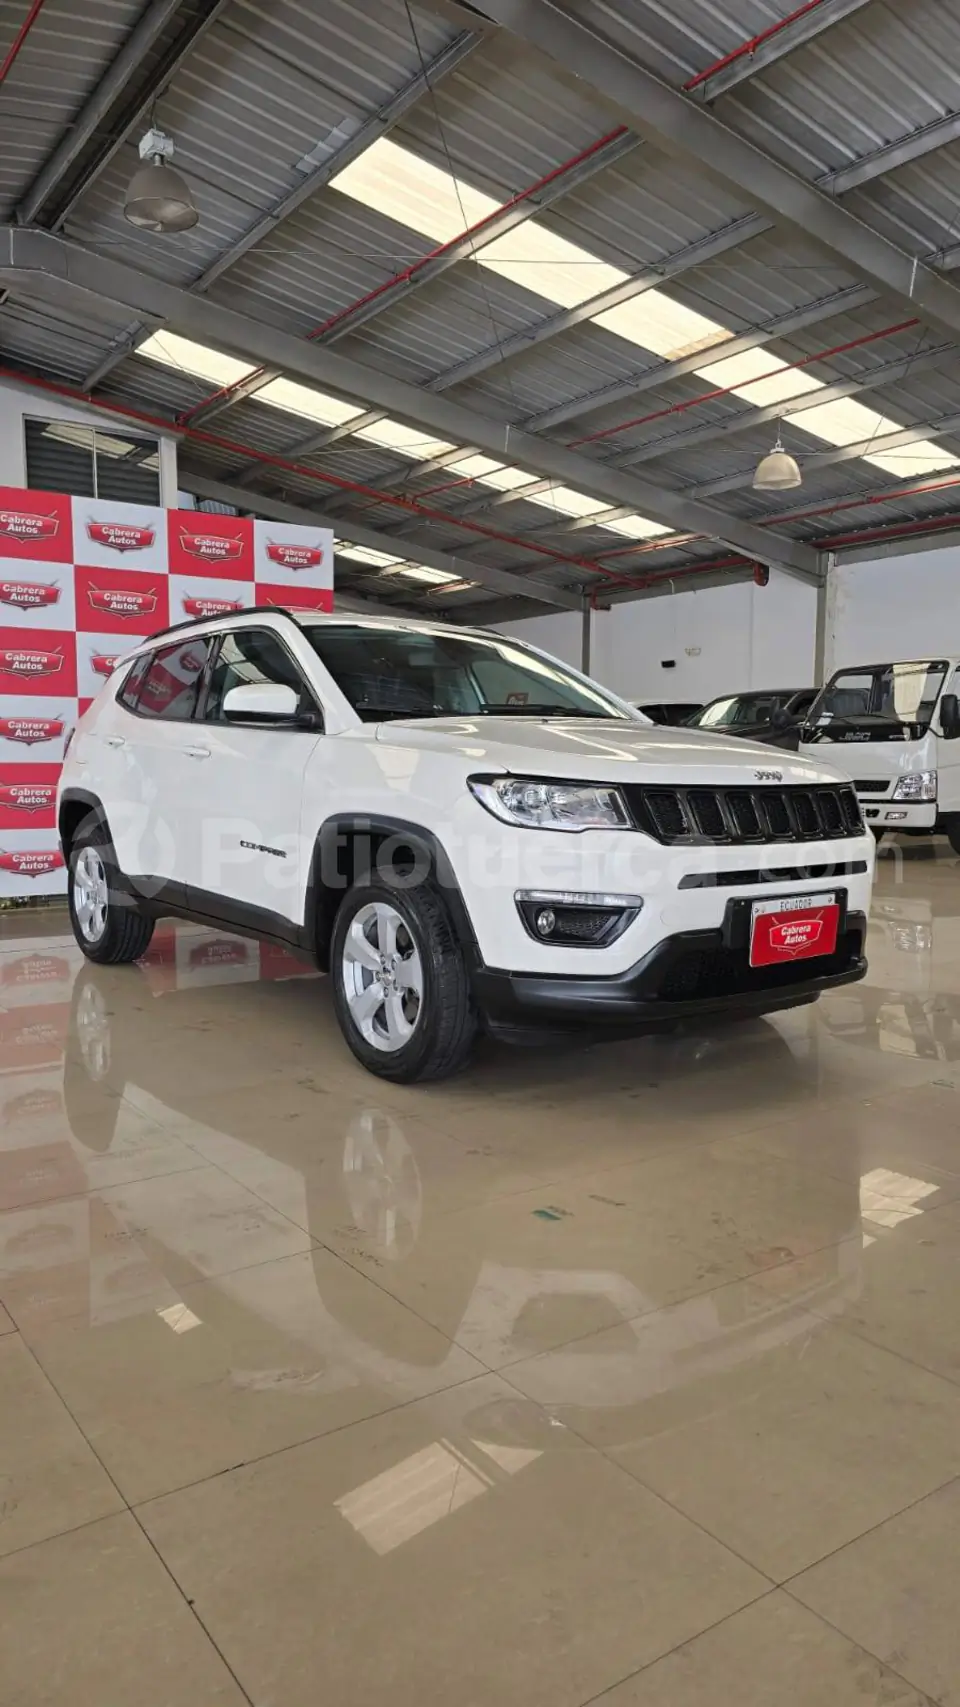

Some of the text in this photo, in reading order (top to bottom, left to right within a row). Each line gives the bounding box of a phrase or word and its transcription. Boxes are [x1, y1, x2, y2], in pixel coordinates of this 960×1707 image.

[0, 514, 42, 527] Cabrera
[7, 523, 37, 534] Autos
[101, 526, 140, 539] Cabrera
[108, 536, 136, 546] Autos
[194, 537, 230, 549] Cabrera
[200, 546, 226, 556] Autos
[278, 547, 311, 558] Cabrera
[283, 556, 307, 565] Autos
[2, 583, 44, 596] Cabrera
[10, 592, 40, 603] Autos
[103, 592, 142, 604] Cabrera
[110, 601, 138, 612] Autos
[195, 601, 231, 611] Cabrera
[5, 652, 47, 664] Cabrera
[12, 661, 42, 671] Autos
[8, 721, 49, 730] Cabrera
[15, 729, 45, 738] Autos
[10, 788, 51, 797] Cabrera
[16, 795, 47, 804] Autos
[12, 854, 53, 863] Cabrera
[19, 860, 49, 870] Autos
[780, 898, 812, 912] ECUADOR
[781, 925, 811, 936] Cabrera
[784, 934, 807, 945] Autos
